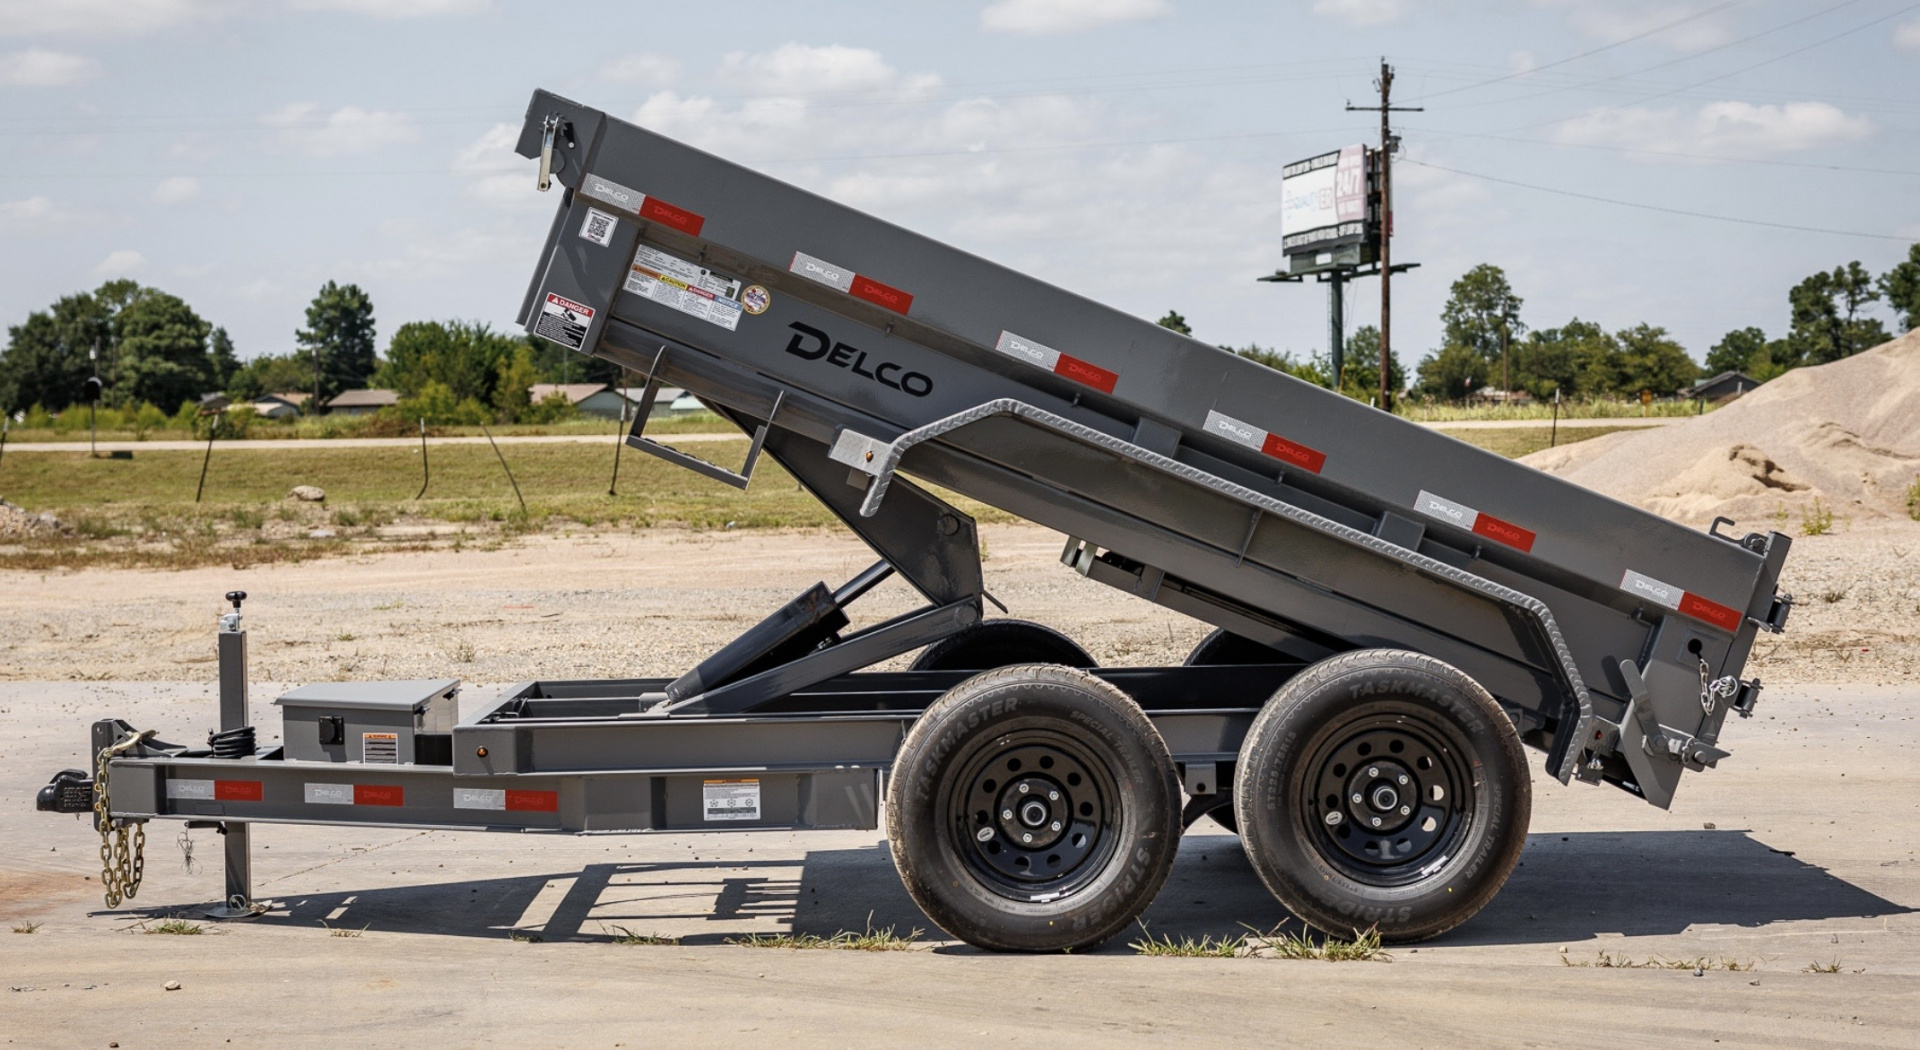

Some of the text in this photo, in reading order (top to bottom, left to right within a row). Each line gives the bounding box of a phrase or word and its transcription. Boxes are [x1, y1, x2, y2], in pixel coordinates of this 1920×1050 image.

[594, 183, 687, 222] DELCO DELCO
[1337, 169, 1361, 197] 24/7
[665, 277, 686, 289] CAUTION
[693, 287, 714, 298] DANGER
[805, 262, 898, 302] DELCO DELCO
[559, 299, 589, 316] DANGER
[718, 297, 739, 308] NOTICE
[785, 321, 933, 397] DELCO
[1010, 340, 1101, 380] DELCO DELCO
[1219, 420, 1310, 461] DELCO DELCO
[1429, 501, 1520, 540] DELCO DELCO
[1635, 580, 1726, 619] DELCO DELCO
[1349, 680, 1485, 734] TASKMASTER
[919, 698, 1018, 800] TASKMASTER
[1070, 710, 1143, 784] SPECIAL TRAILER
[225, 786, 252, 794] DELCO
[1268, 731, 1297, 810] ST225/75R15
[314, 789, 391, 798] DELCO DELCO
[1489, 782, 1502, 830] SPECIAL
[1465, 835, 1496, 879] TRAILER
[1072, 846, 1151, 929] STRIDER
